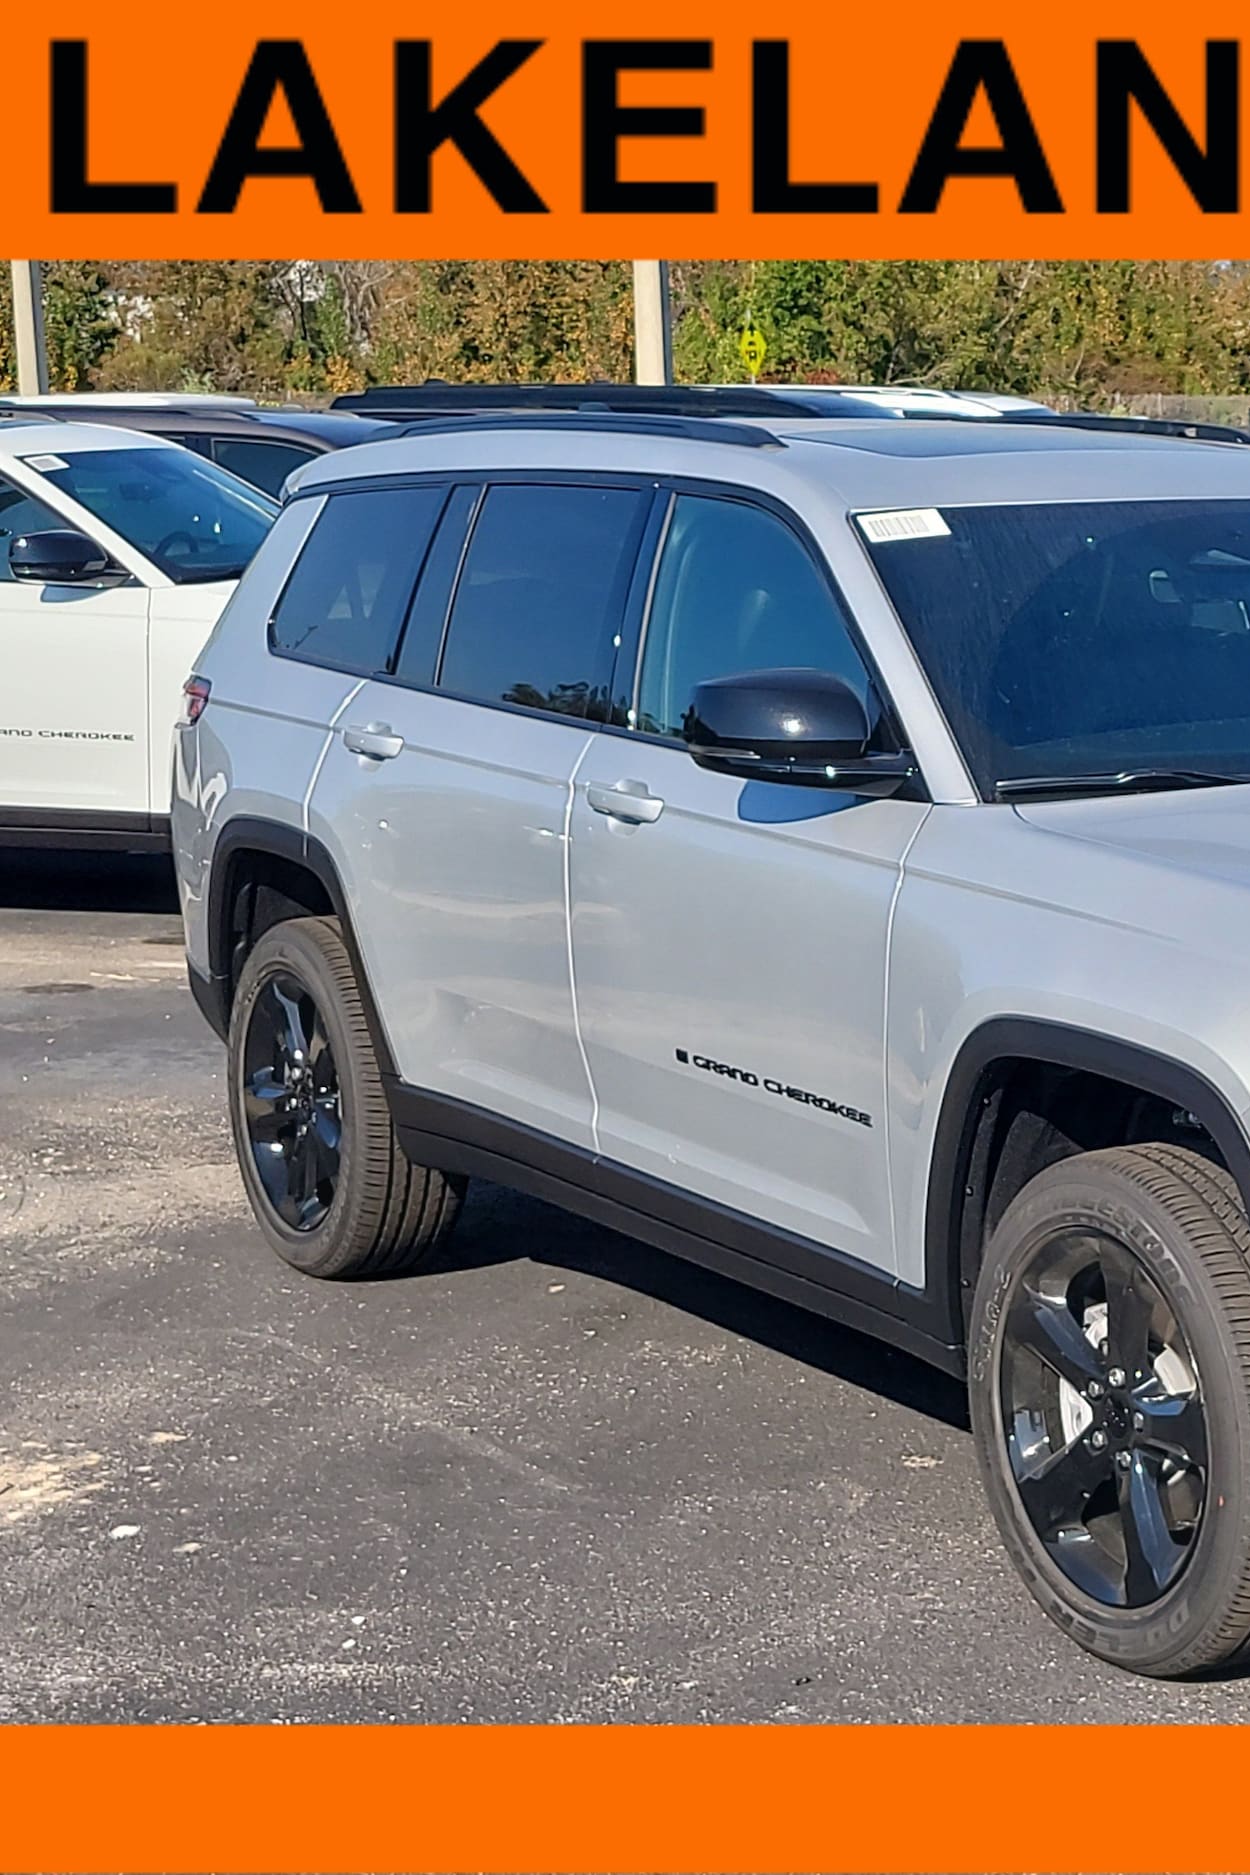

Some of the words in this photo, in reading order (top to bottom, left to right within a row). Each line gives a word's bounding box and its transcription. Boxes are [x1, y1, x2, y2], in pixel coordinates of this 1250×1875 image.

[38, 730, 134, 741] CHEROKEE
[693, 1055, 759, 1086] GRAND
[763, 1079, 873, 1128] CHEROKEE
